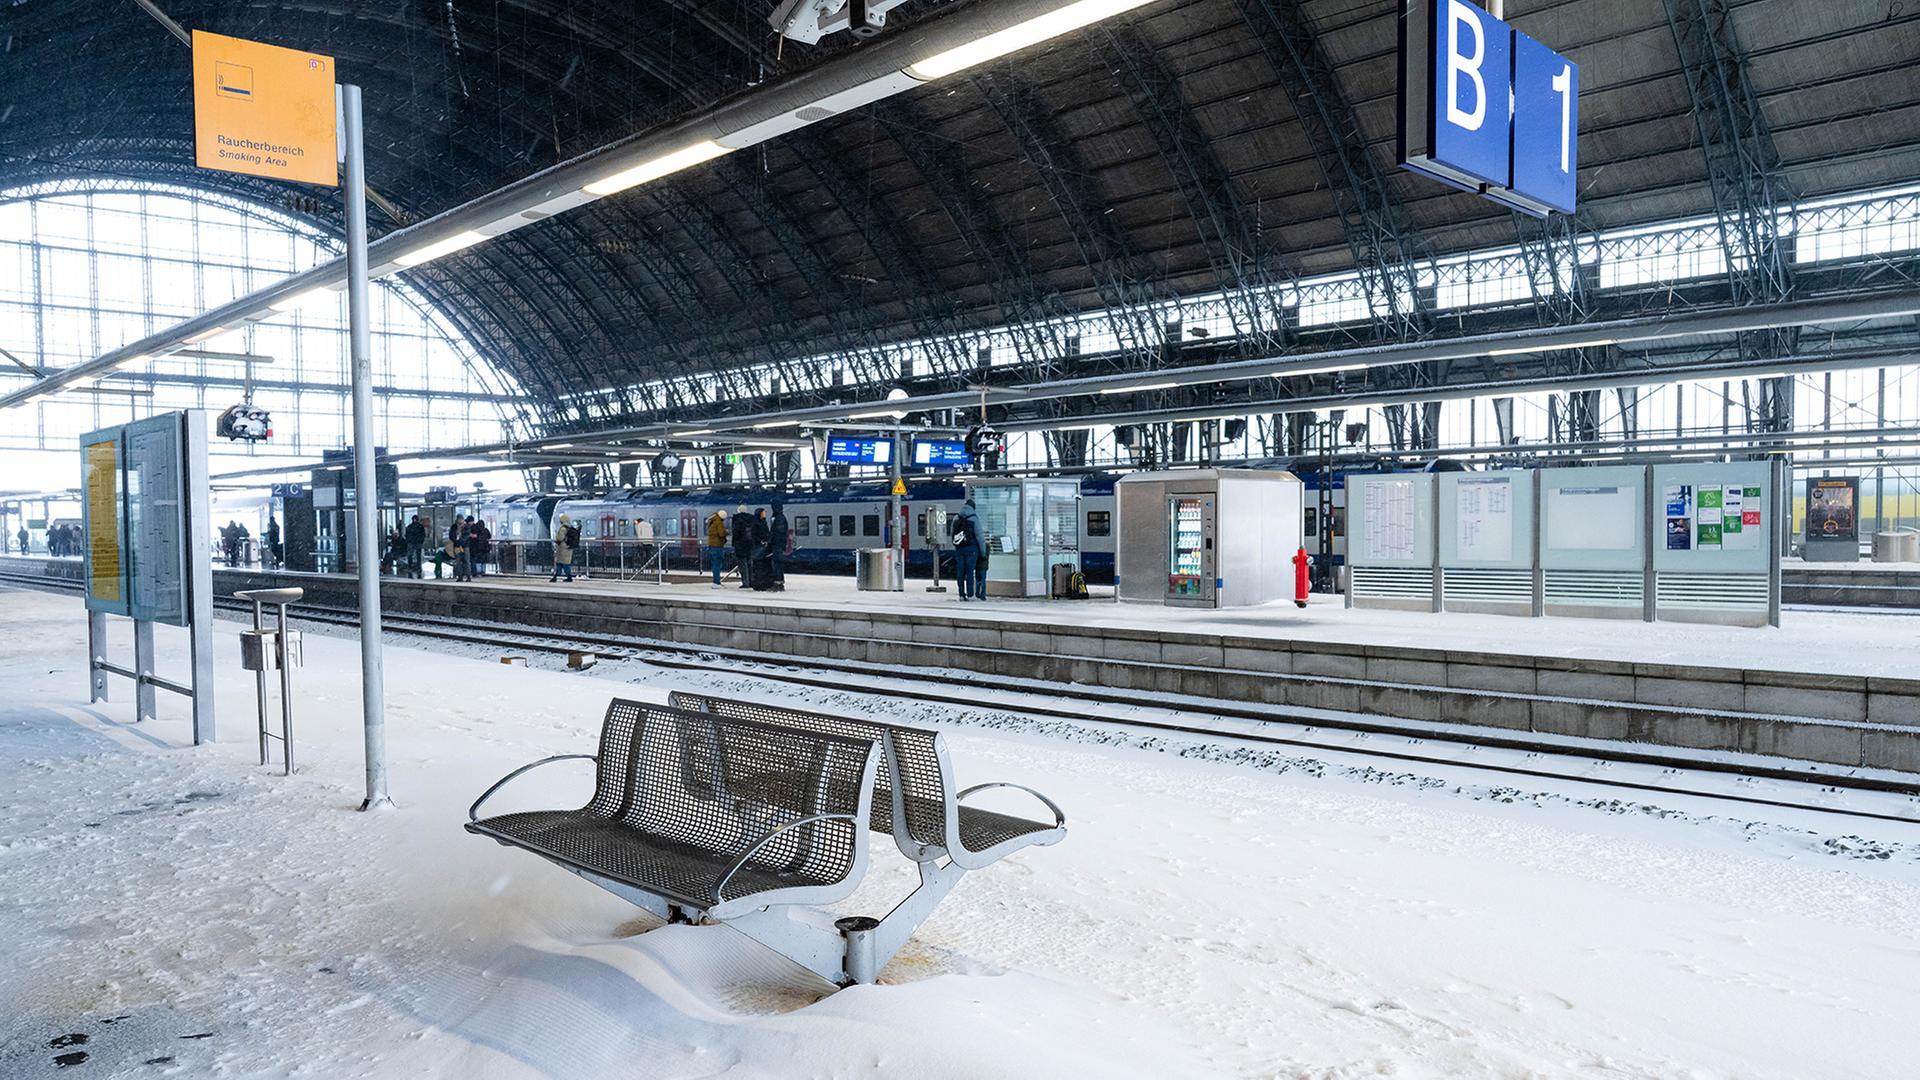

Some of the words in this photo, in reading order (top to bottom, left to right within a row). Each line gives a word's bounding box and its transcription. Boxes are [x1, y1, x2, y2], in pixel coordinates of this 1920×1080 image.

[1447, 0, 1486, 131] B
[1552, 63, 1571, 174] 1
[217, 134, 304, 156] Raucherbereich
[218, 149, 261, 165] Smoking
[265, 156, 287, 167] Area
[274, 484, 282, 495] 2
[289, 483, 299, 495] C
